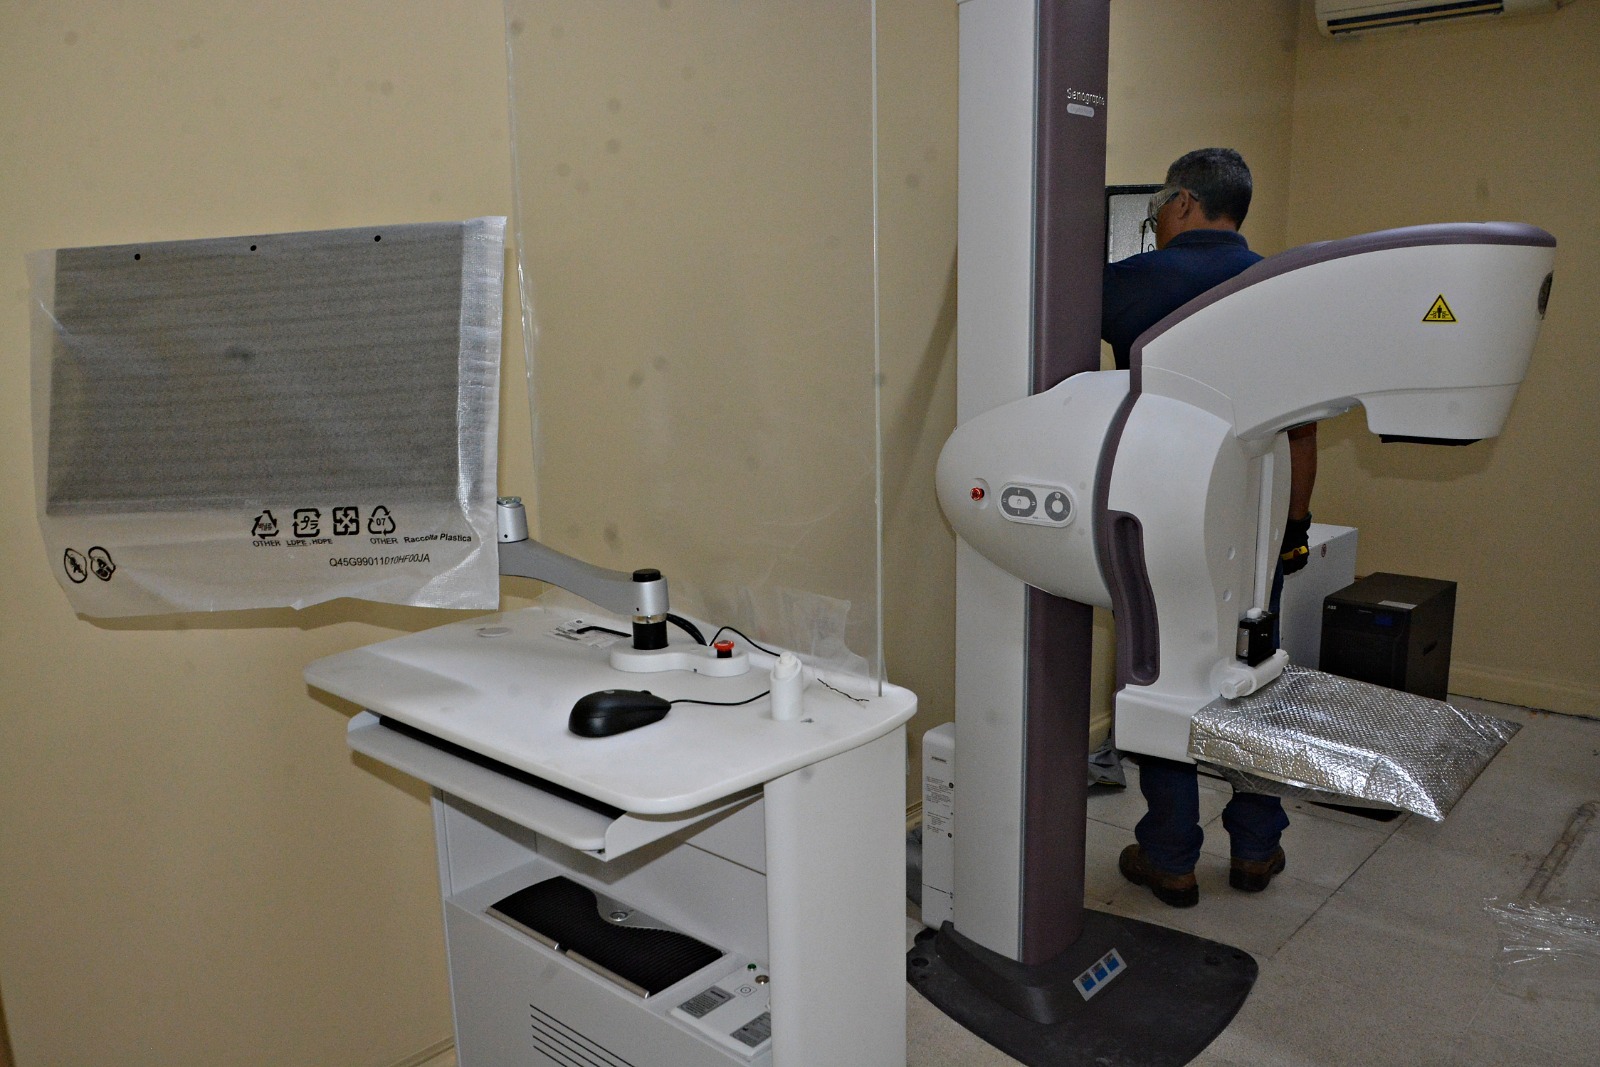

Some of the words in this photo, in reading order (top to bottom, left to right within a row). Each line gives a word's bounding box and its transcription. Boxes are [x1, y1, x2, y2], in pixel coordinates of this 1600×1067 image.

[300, 515, 319, 531] プラ
[376, 517, 386, 526] 07
[370, 537, 398, 545] OTHER
[404, 534, 438, 543] Raccolta
[440, 533, 472, 543] Plastica
